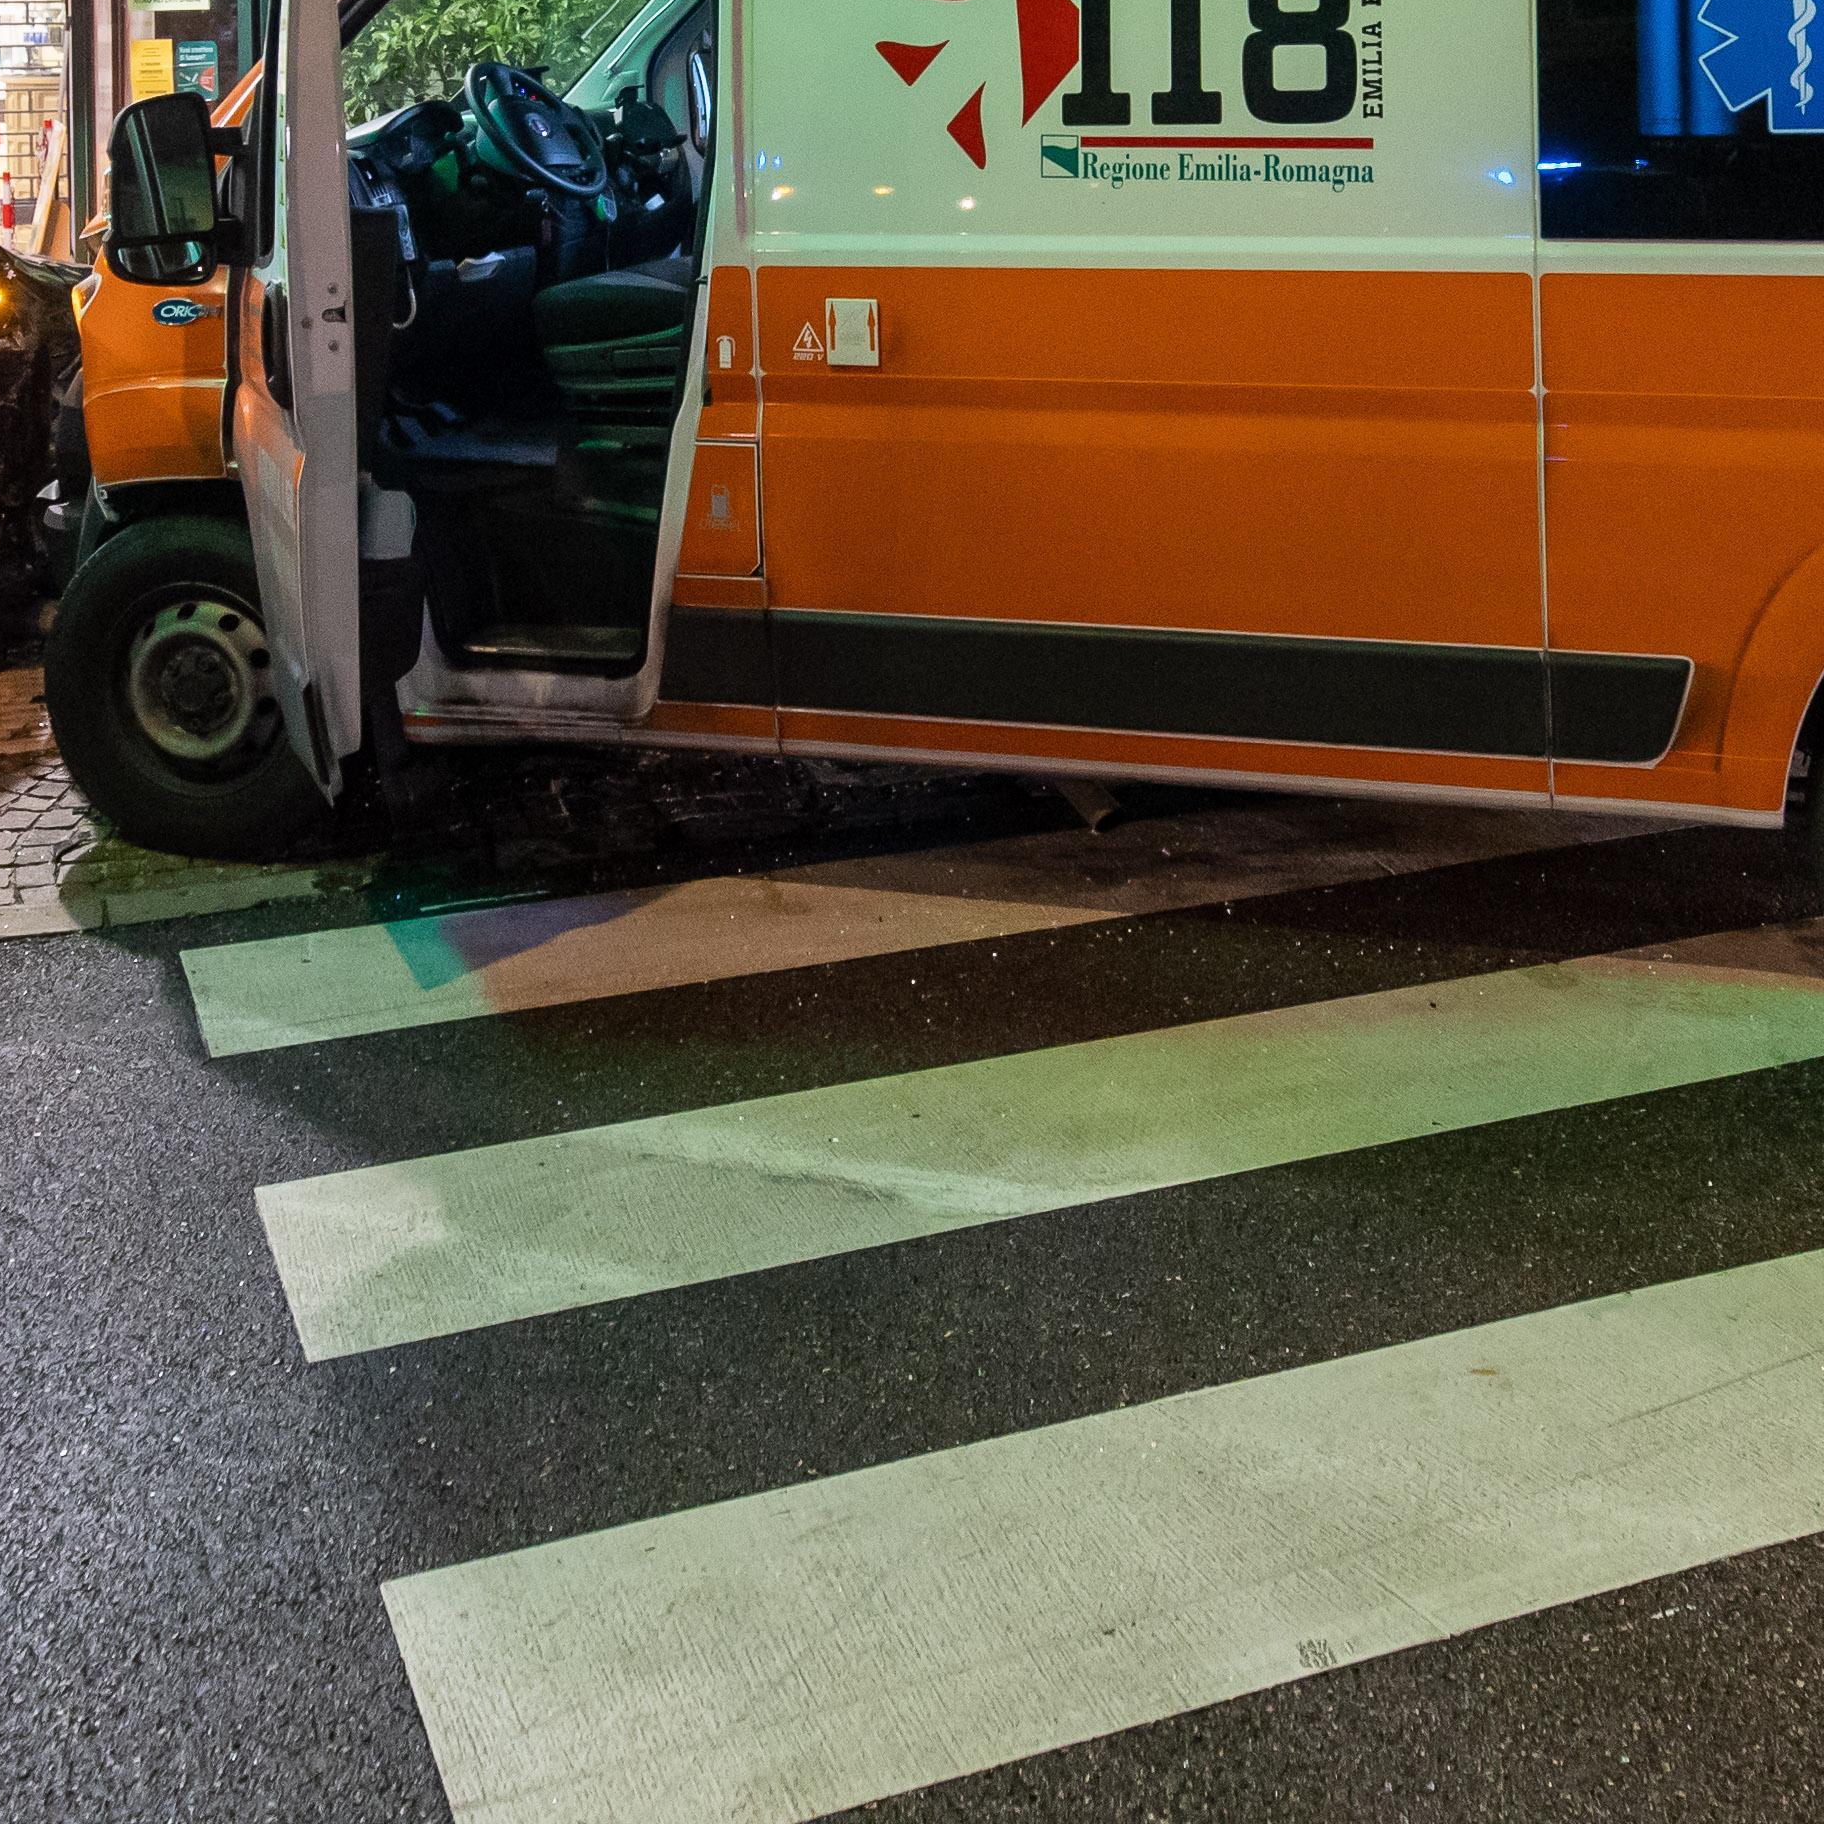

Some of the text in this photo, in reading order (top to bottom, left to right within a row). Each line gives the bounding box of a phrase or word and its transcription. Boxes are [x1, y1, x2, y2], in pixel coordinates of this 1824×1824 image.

[1361, 20, 1384, 119] EMILIA
[1082, 152, 1374, 193] Regione Emilia-Romagna
